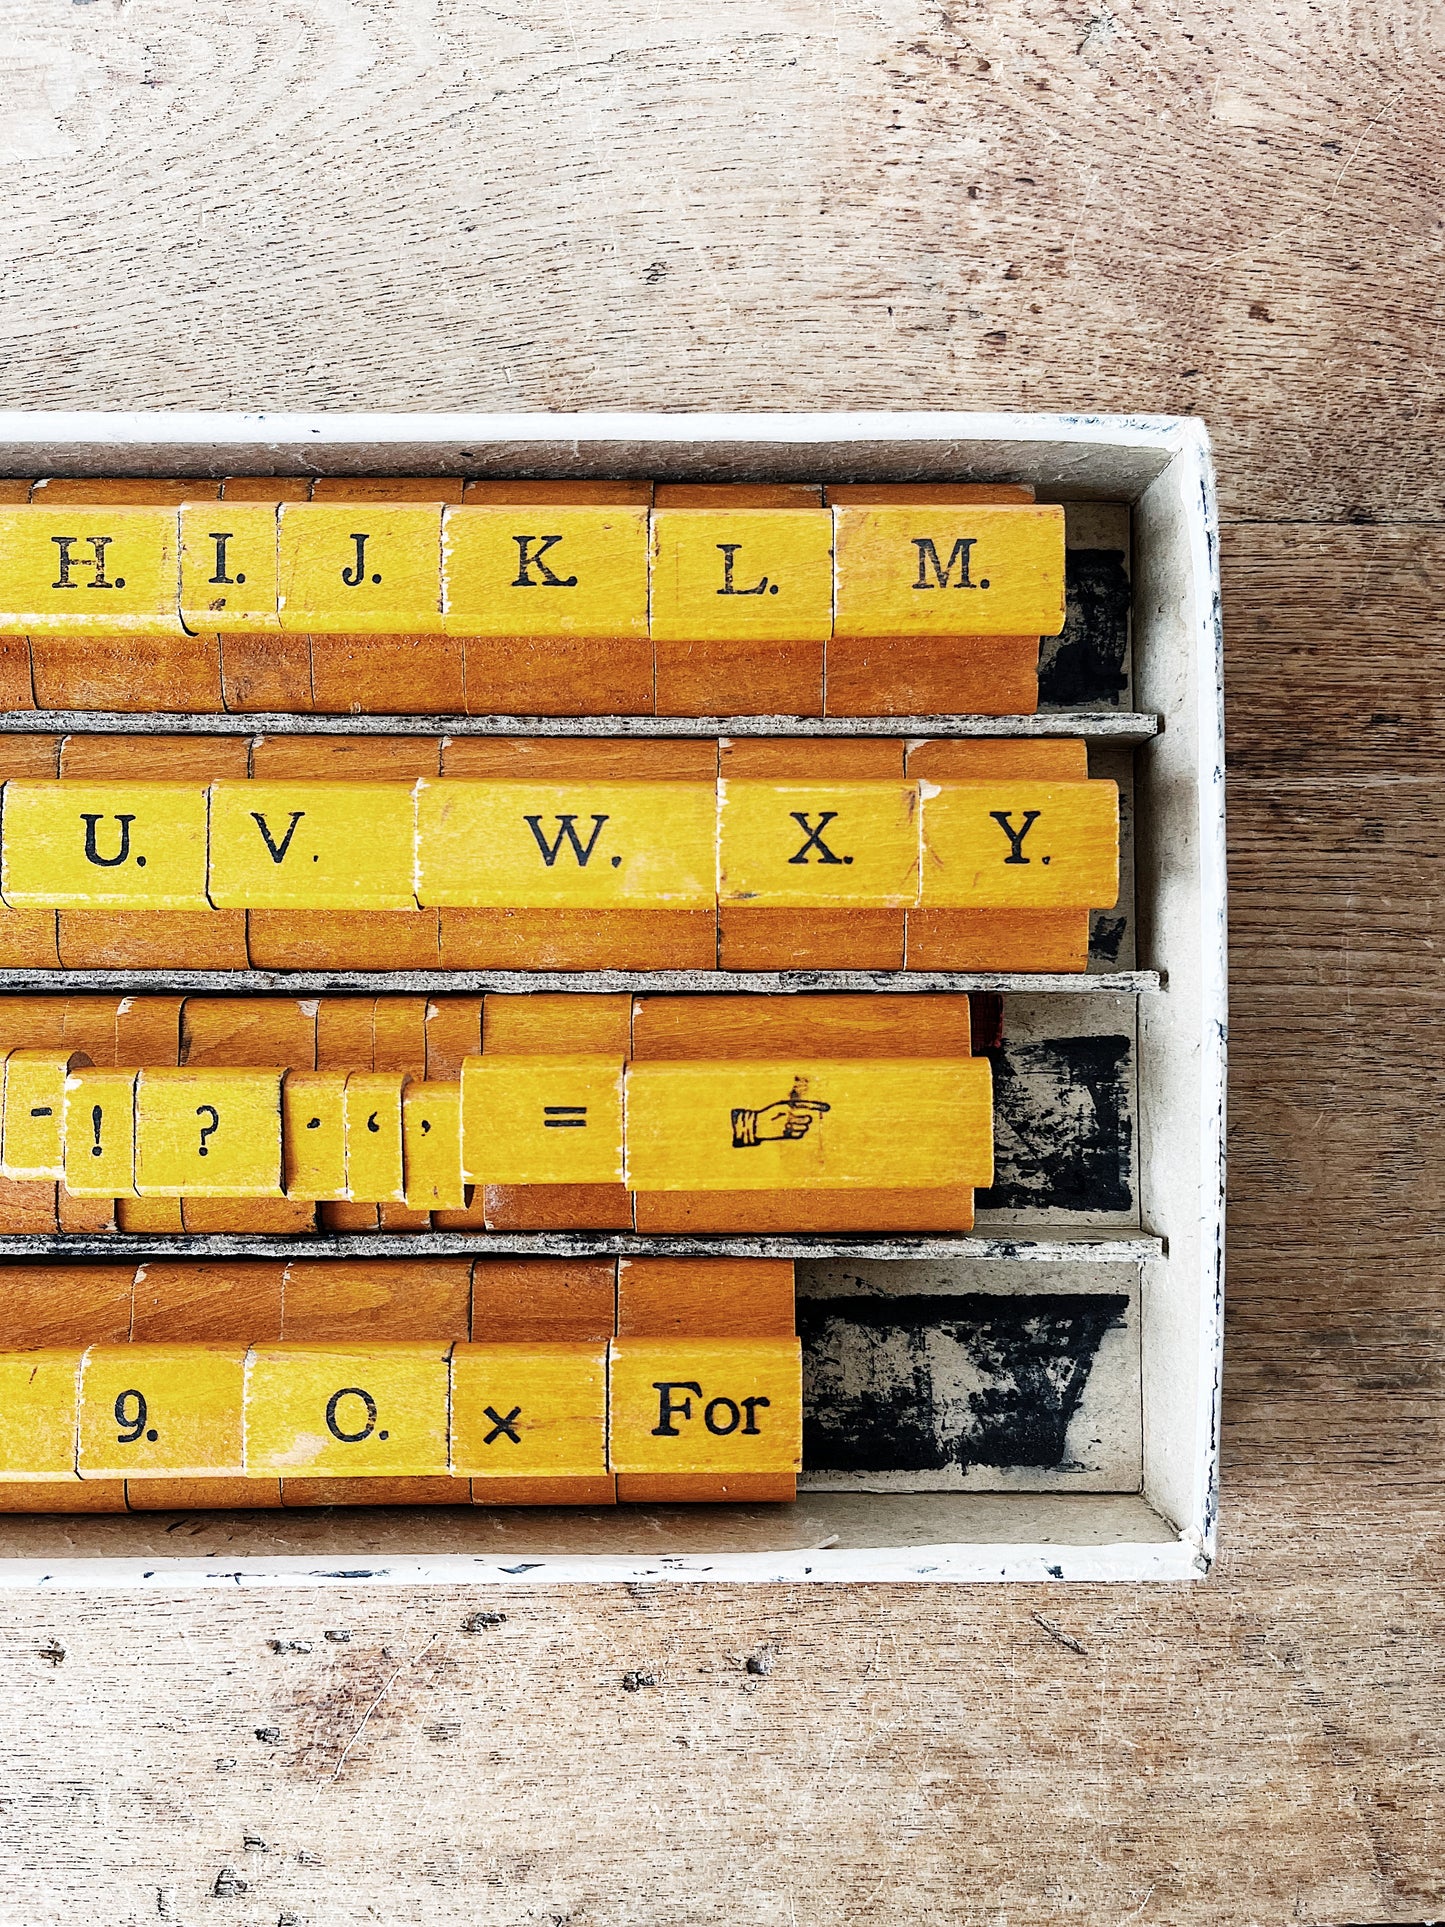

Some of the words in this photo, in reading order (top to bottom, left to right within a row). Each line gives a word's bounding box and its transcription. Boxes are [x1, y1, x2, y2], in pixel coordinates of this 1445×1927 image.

[51, 536, 126, 589] H.
[208, 533, 246, 584] I.
[341, 533, 382, 587] J.
[510, 535, 578, 587] K.
[715, 543, 779, 595] L.
[910, 538, 990, 590] M.
[79, 813, 147, 868] U.
[250, 811, 319, 864] V.
[523, 814, 622, 868] W.
[787, 811, 854, 865] X.
[989, 810, 1051, 866] Y.
[91, 1104, 103, 1157] !
[196, 1105, 219, 1157] ?
[114, 1388, 159, 1443] 9.
[650, 1381, 771, 1437] For
